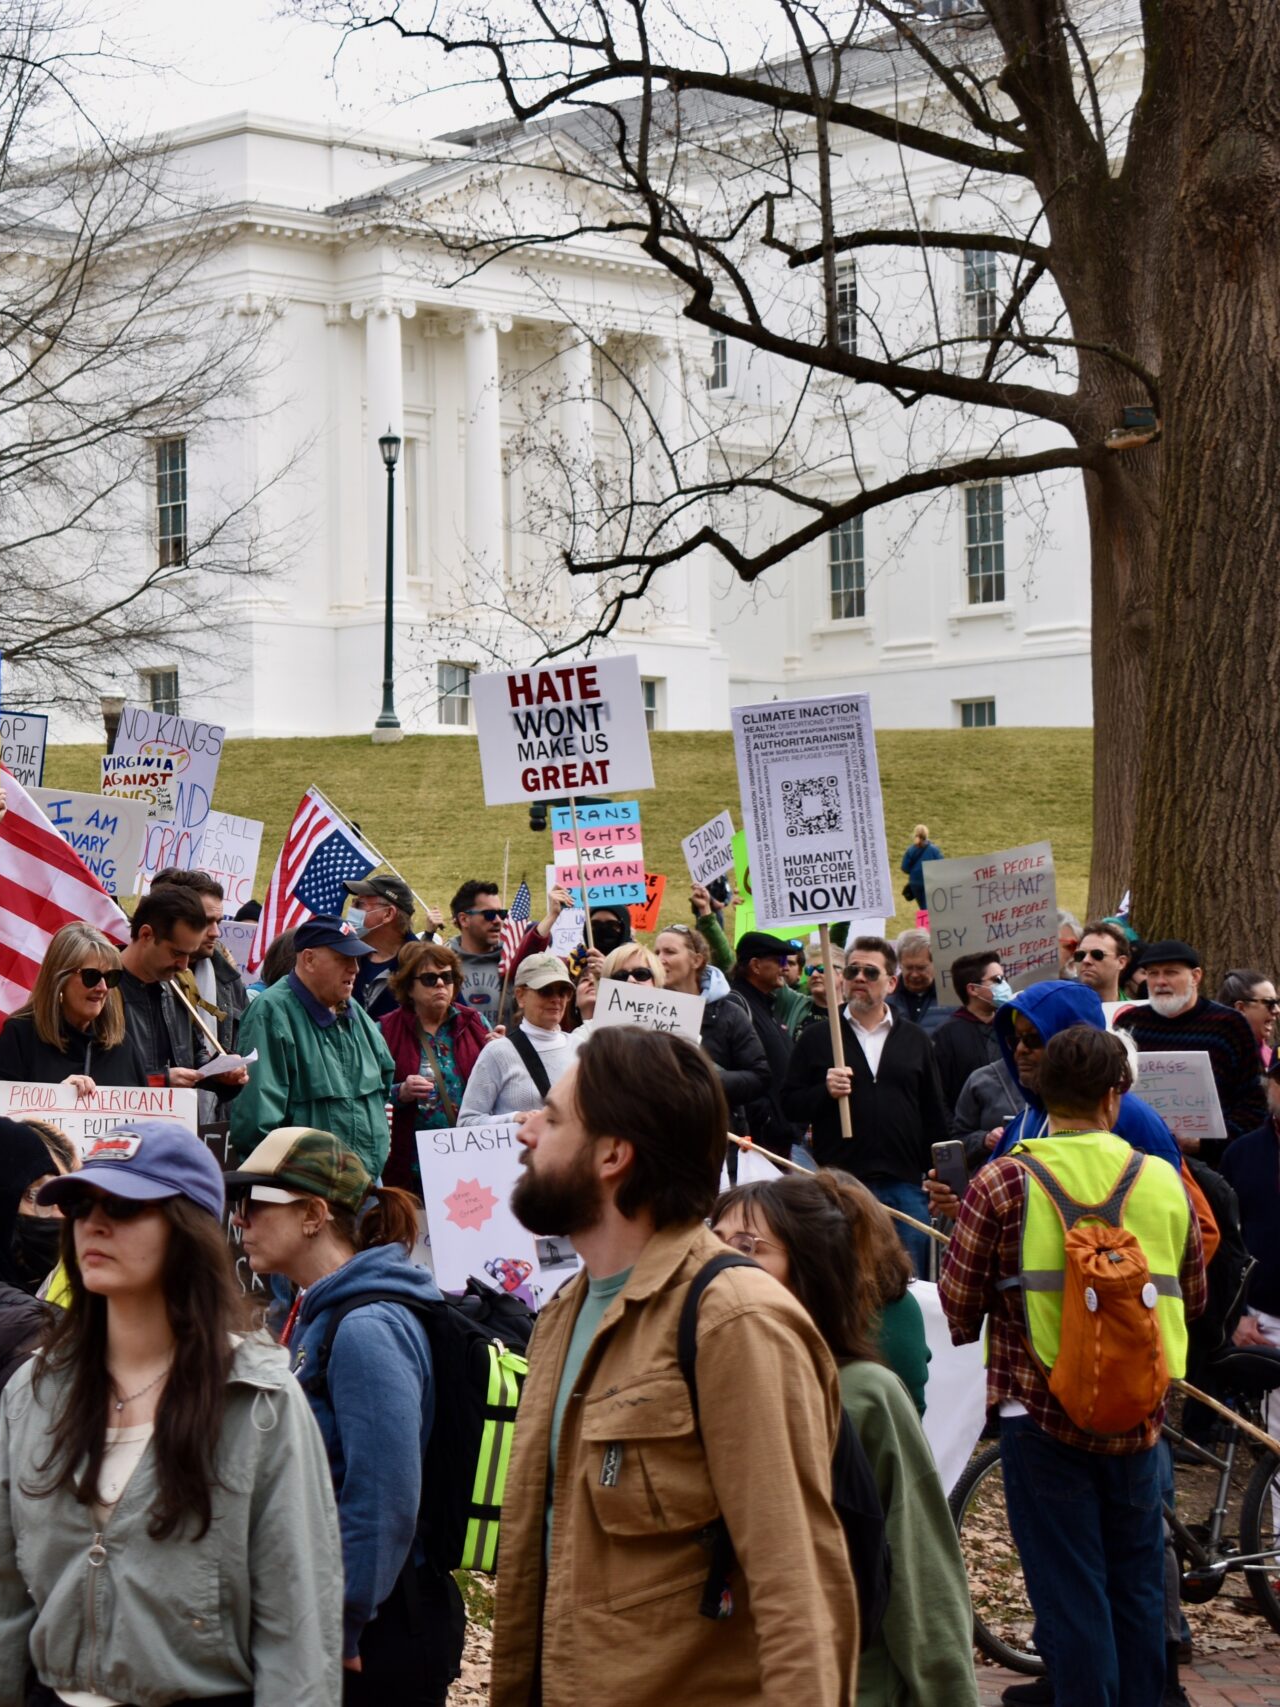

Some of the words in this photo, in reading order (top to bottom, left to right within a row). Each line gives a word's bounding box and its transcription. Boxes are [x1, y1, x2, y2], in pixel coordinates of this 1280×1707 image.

[507, 665, 601, 707] HATE
[513, 702, 603, 740] WONT
[742, 709, 796, 725] CLIMATE
[799, 702, 859, 719] INACTION
[0, 717, 27, 740] OP
[116, 707, 150, 742] NO
[155, 715, 224, 756] KINGS
[744, 725, 776, 734] HEALTH
[753, 732, 784, 740] PRIVACY
[855, 722, 864, 748] ARMED
[517, 737, 576, 762] MAKE
[582, 733, 609, 754] US
[753, 732, 856, 751] AUTHORITARIANISM
[16, 745, 40, 765] THE
[103, 755, 174, 771] VIRGINIA
[745, 735, 756, 786] DISINFORMATION
[858, 748, 869, 784] CONFLICT
[102, 772, 173, 789] AGAINST
[521, 759, 610, 792] GREAT
[47, 800, 73, 824] I
[85, 809, 119, 835] AM
[216, 816, 255, 841] ALL
[558, 808, 632, 825] TRANS
[759, 796, 769, 841] TECHNOLOGY
[559, 827, 637, 845] RGHTS
[689, 820, 725, 858] STAND
[209, 851, 246, 875] AND
[581, 846, 616, 862] ARE
[692, 843, 735, 883] UKRAINE
[783, 849, 853, 867] HUMANITY
[870, 849, 879, 877] MEDICAL
[563, 864, 639, 882] HUMAN
[765, 852, 774, 883] EFFECTS
[785, 865, 817, 878] MUST
[820, 861, 855, 873] COME
[785, 871, 856, 888] TOGETHER
[973, 865, 997, 880] THE
[1003, 856, 1046, 876] PEOPLE
[768, 883, 778, 918] COGNITIVE
[789, 885, 857, 913] NOW
[932, 885, 963, 913] OF
[982, 909, 1008, 924] THE
[1011, 899, 1049, 918] PEOPLE
[936, 927, 967, 950] BY
[986, 915, 1046, 943] MUSK
[1018, 935, 1056, 955] PEOPLE
[9, 1085, 57, 1108] PROUD
[84, 1118, 135, 1135] PUTI
[433, 1128, 512, 1155] SLASH
